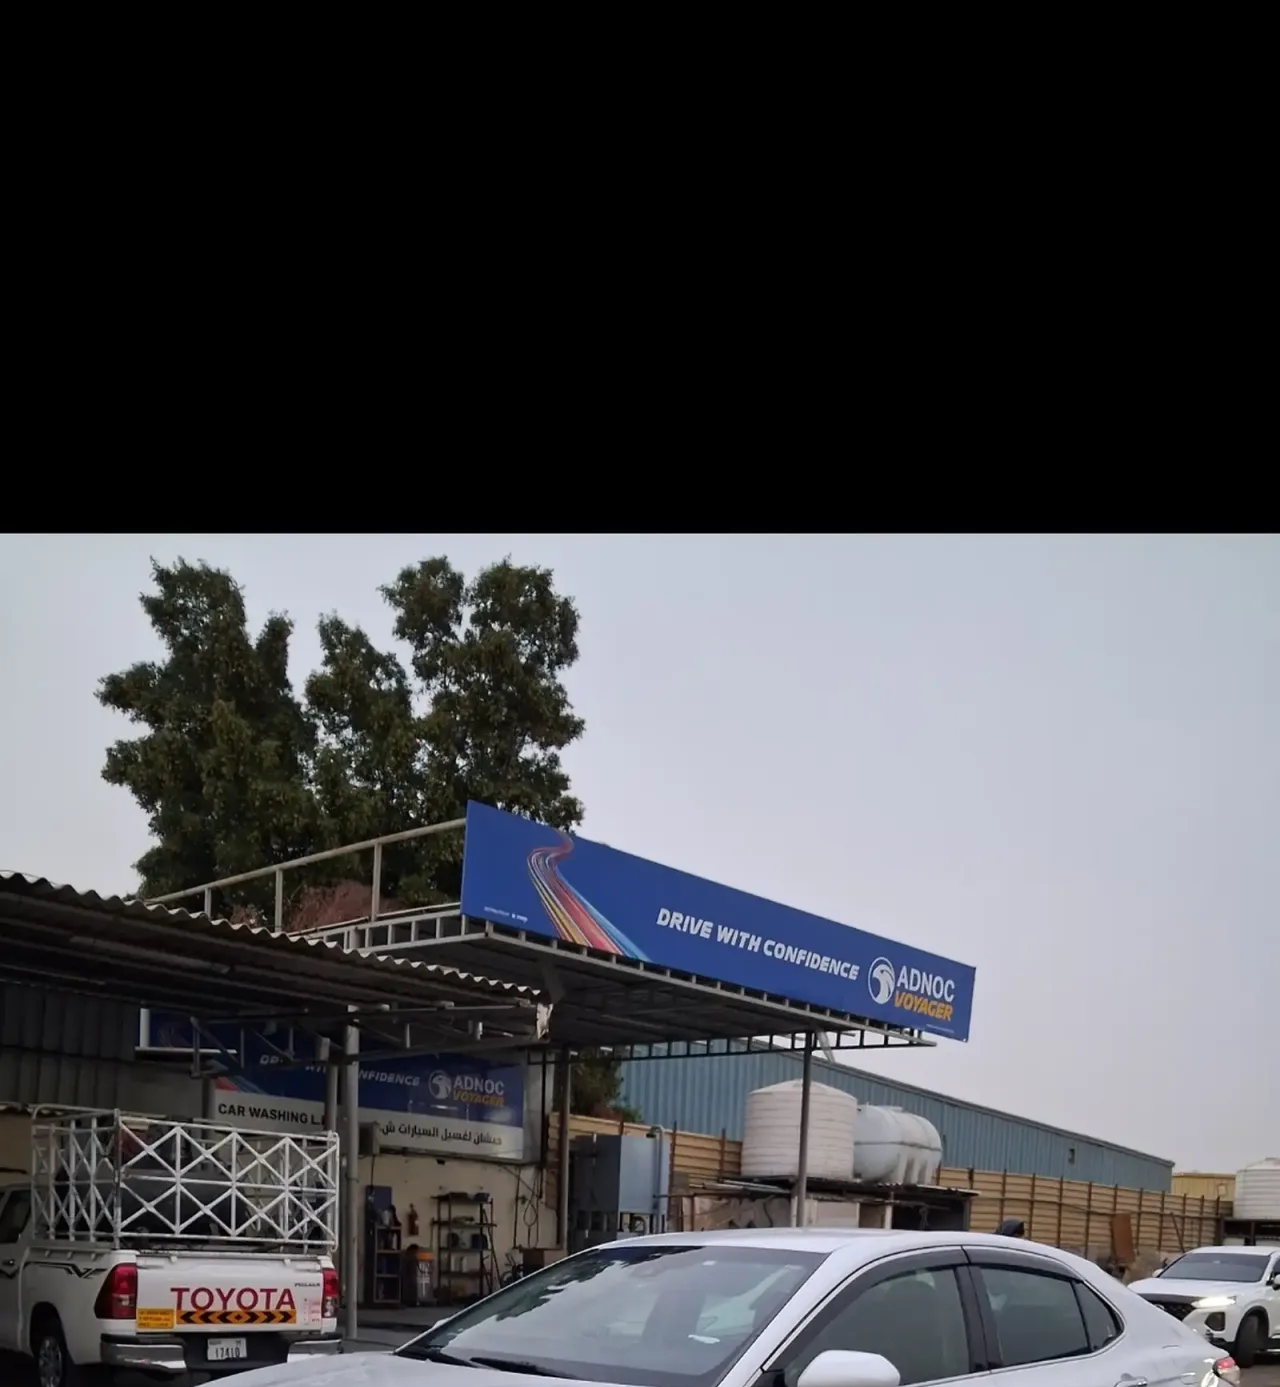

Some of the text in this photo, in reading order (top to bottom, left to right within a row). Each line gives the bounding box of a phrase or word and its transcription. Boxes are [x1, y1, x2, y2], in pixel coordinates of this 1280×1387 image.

[656, 907, 860, 981] DRIVE WITH CONFIDENCE
[896, 965, 955, 1003] ADNOC
[894, 990, 953, 1021] VOYAGER
[358, 1069, 421, 1087] NFIDENCE
[453, 1075, 505, 1096] ADNOC
[218, 1103, 245, 1117] CAR
[248, 1106, 308, 1124] WASHING
[398, 1122, 439, 1138] السيارات
[170, 1287, 296, 1311] TOYOTA
